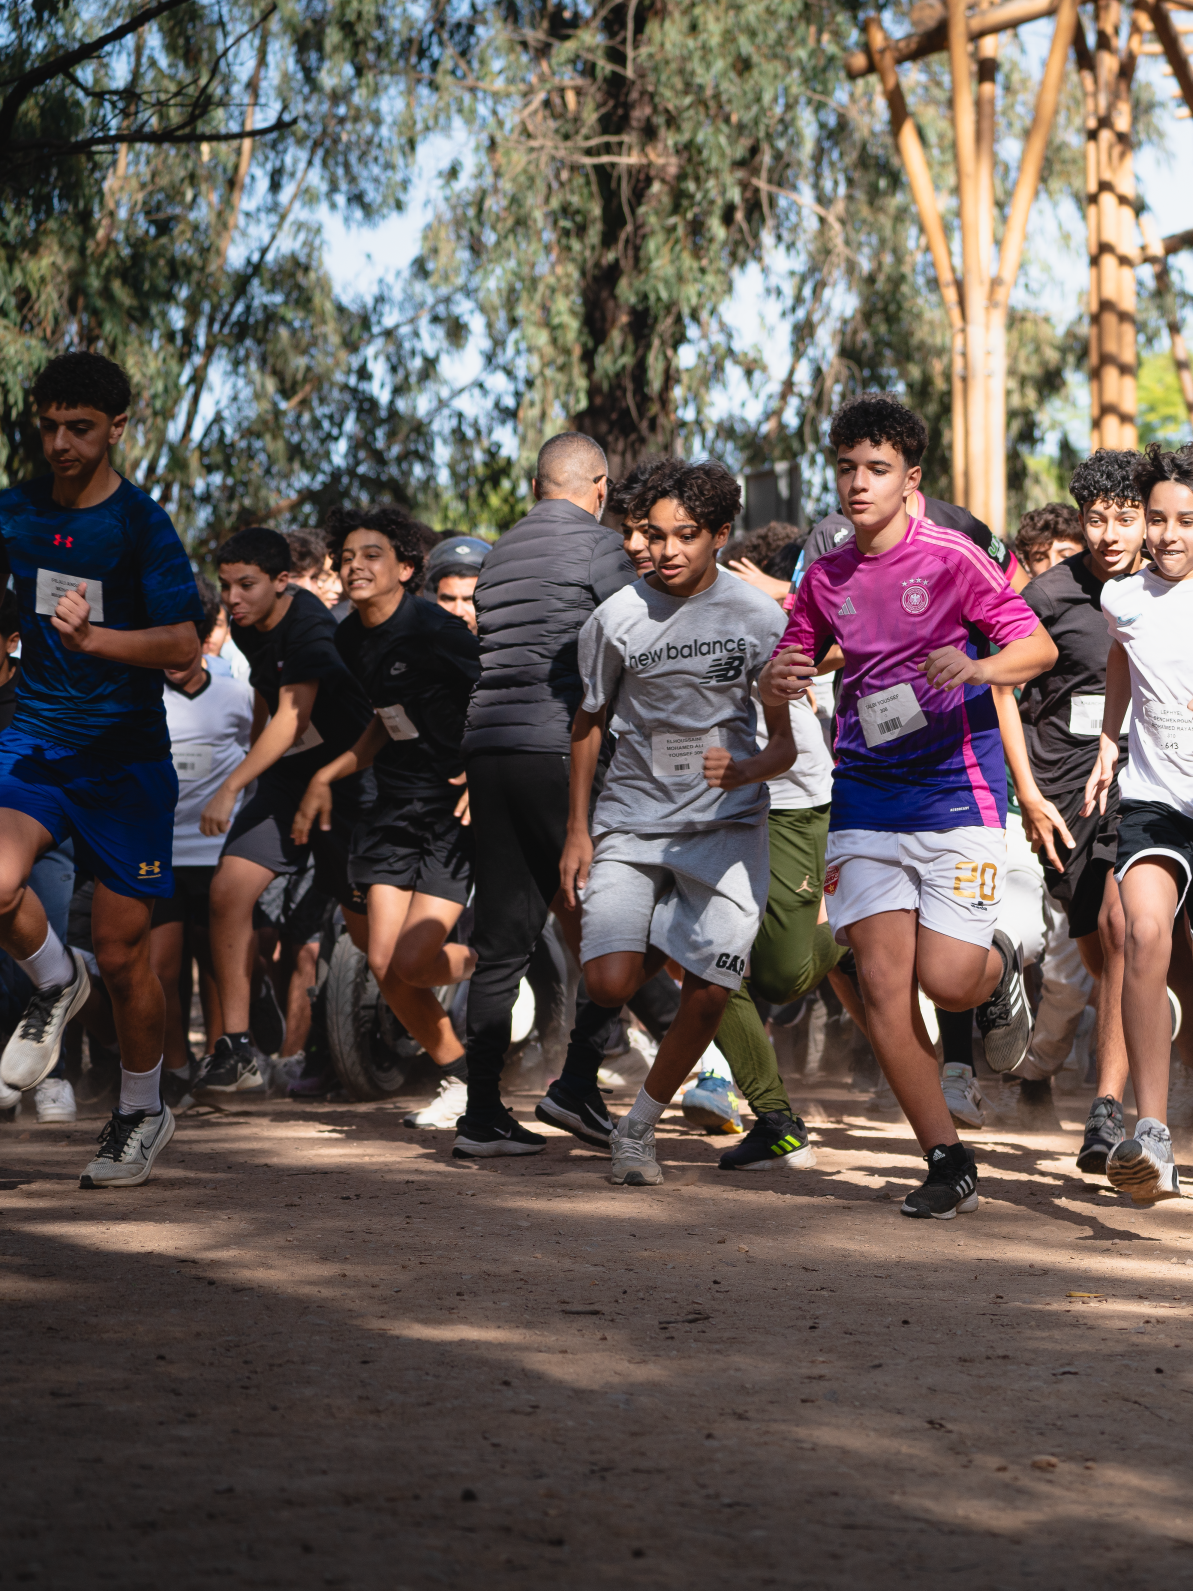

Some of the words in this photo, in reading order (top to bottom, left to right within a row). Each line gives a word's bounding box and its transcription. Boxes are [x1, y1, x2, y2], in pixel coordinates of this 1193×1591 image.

[629, 648, 664, 669] new
[666, 637, 747, 661] balance
[877, 693, 900, 706] YOUSSEF
[953, 861, 998, 902] 20
